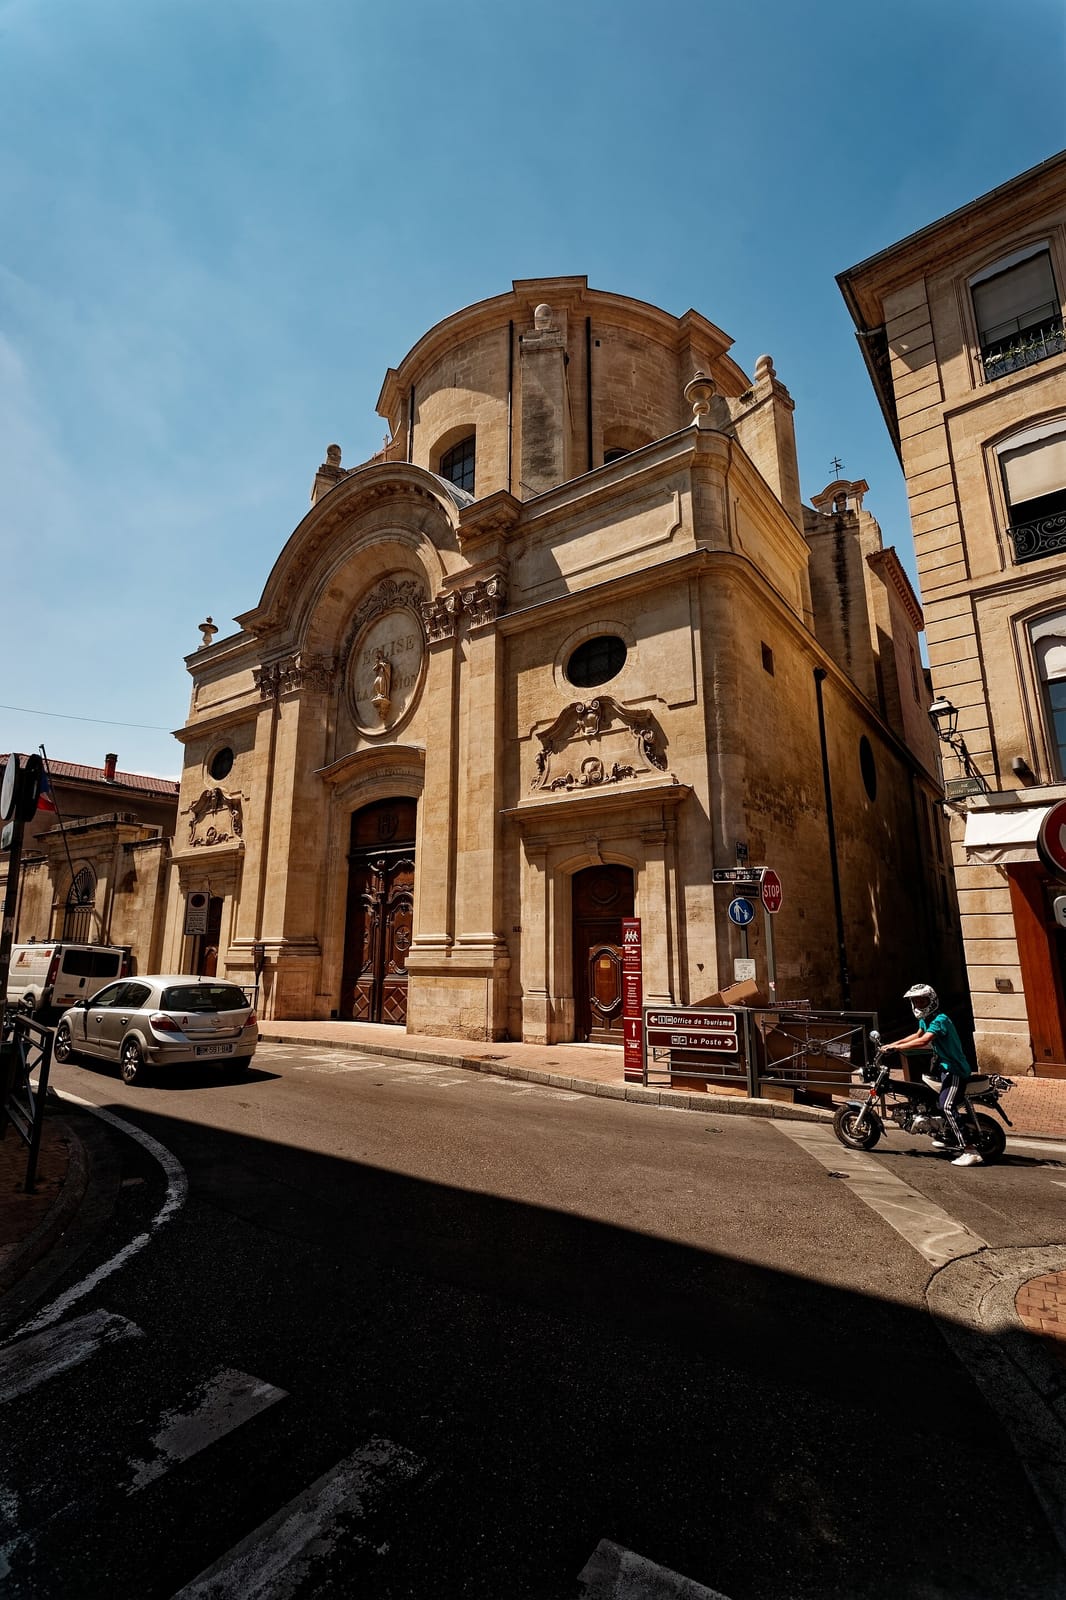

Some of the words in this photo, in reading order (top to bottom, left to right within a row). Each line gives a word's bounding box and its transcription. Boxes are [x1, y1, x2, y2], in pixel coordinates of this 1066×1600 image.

[763, 884, 780, 898] STOP
[182, 1016, 189, 1025] A
[673, 1015, 692, 1025] Office
[693, 1017, 702, 1025] de
[703, 1018, 732, 1027] Tourisme
[700, 1038, 722, 1046] Poste
